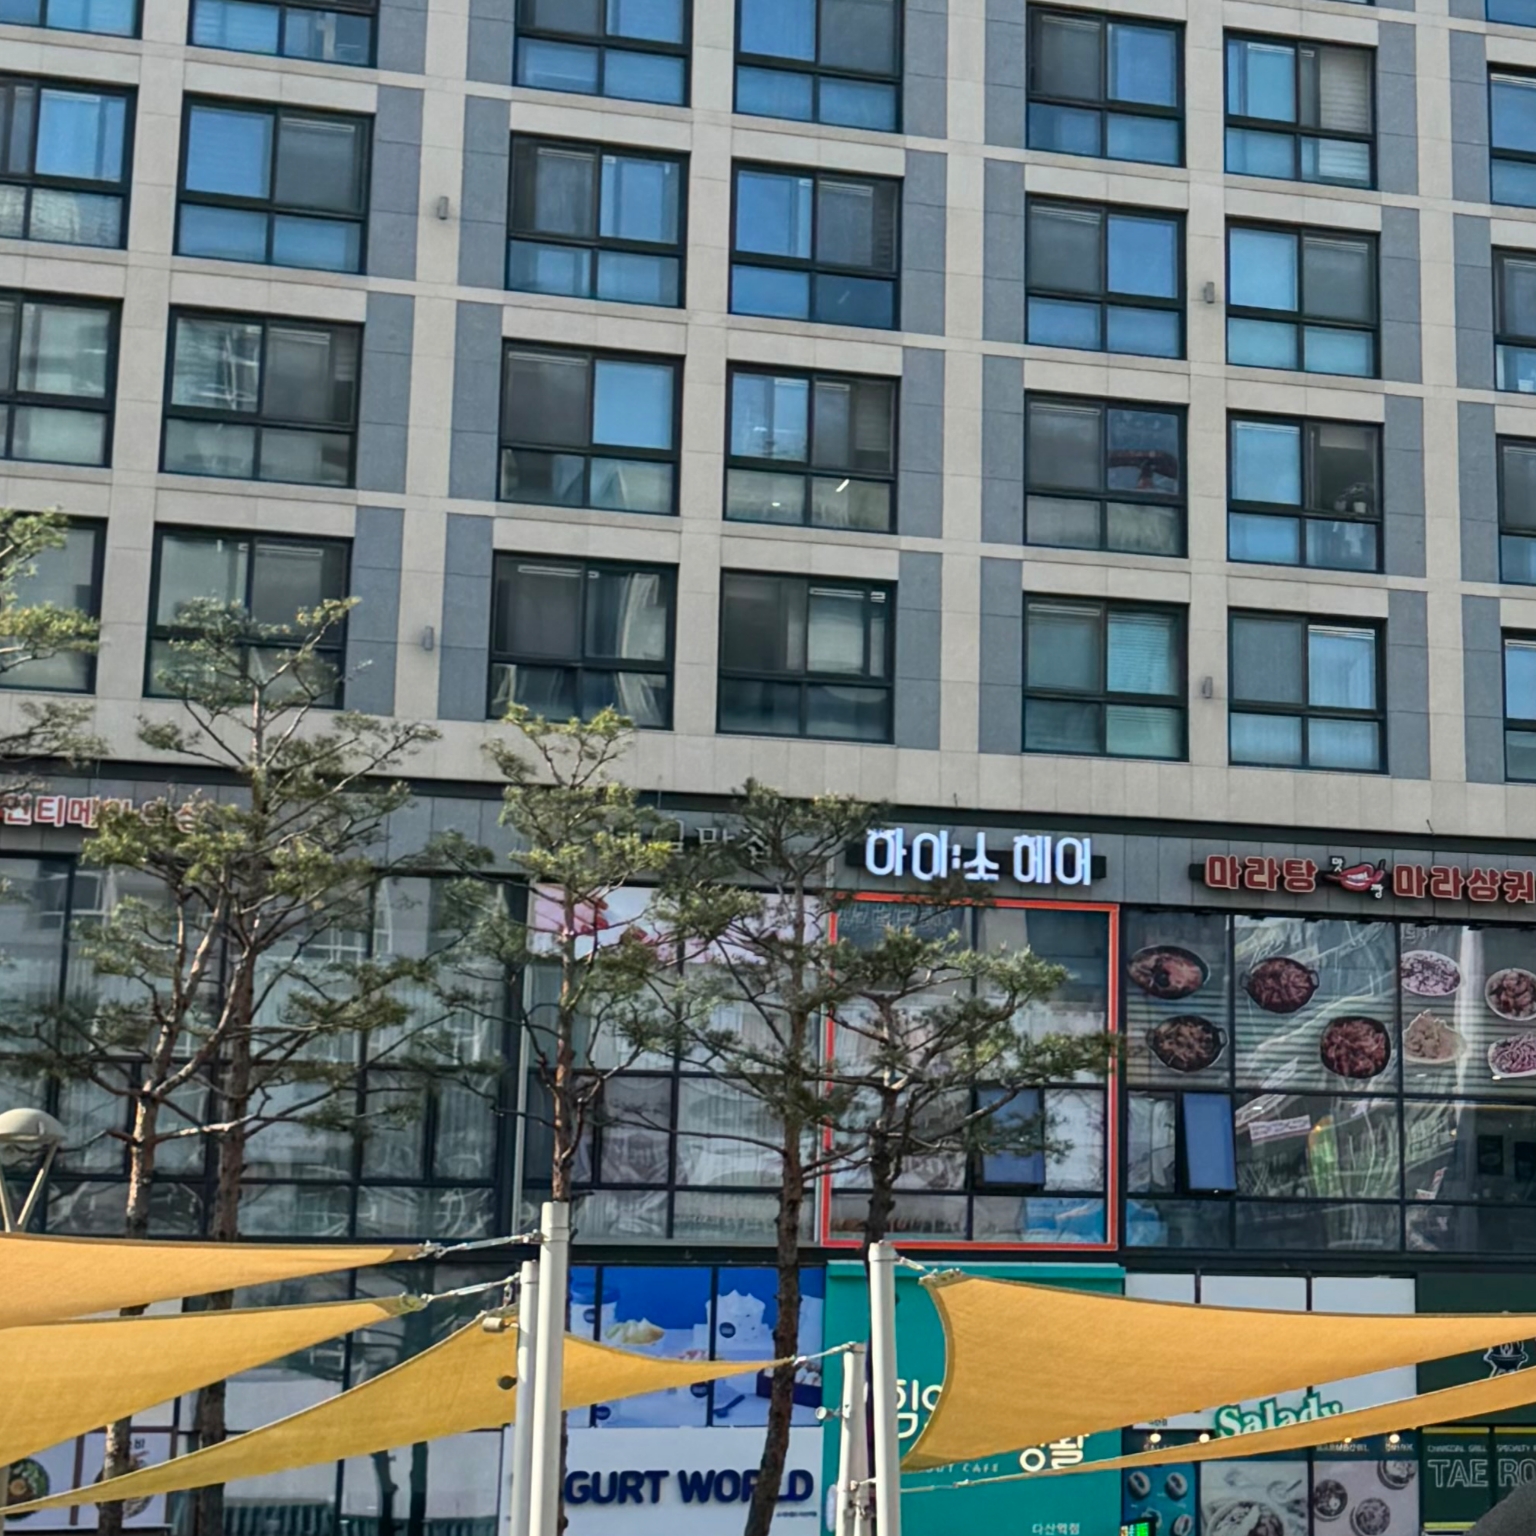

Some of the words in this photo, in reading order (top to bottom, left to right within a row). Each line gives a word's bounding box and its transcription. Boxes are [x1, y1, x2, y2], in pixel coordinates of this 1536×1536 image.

[1013, 833, 1092, 886] 헤어
[1205, 854, 1318, 893] 마라탕
[1392, 863, 1536, 904] 마라샹궈
[564, 1470, 670, 1504] GURT
[1427, 1458, 1490, 1488] TAE
